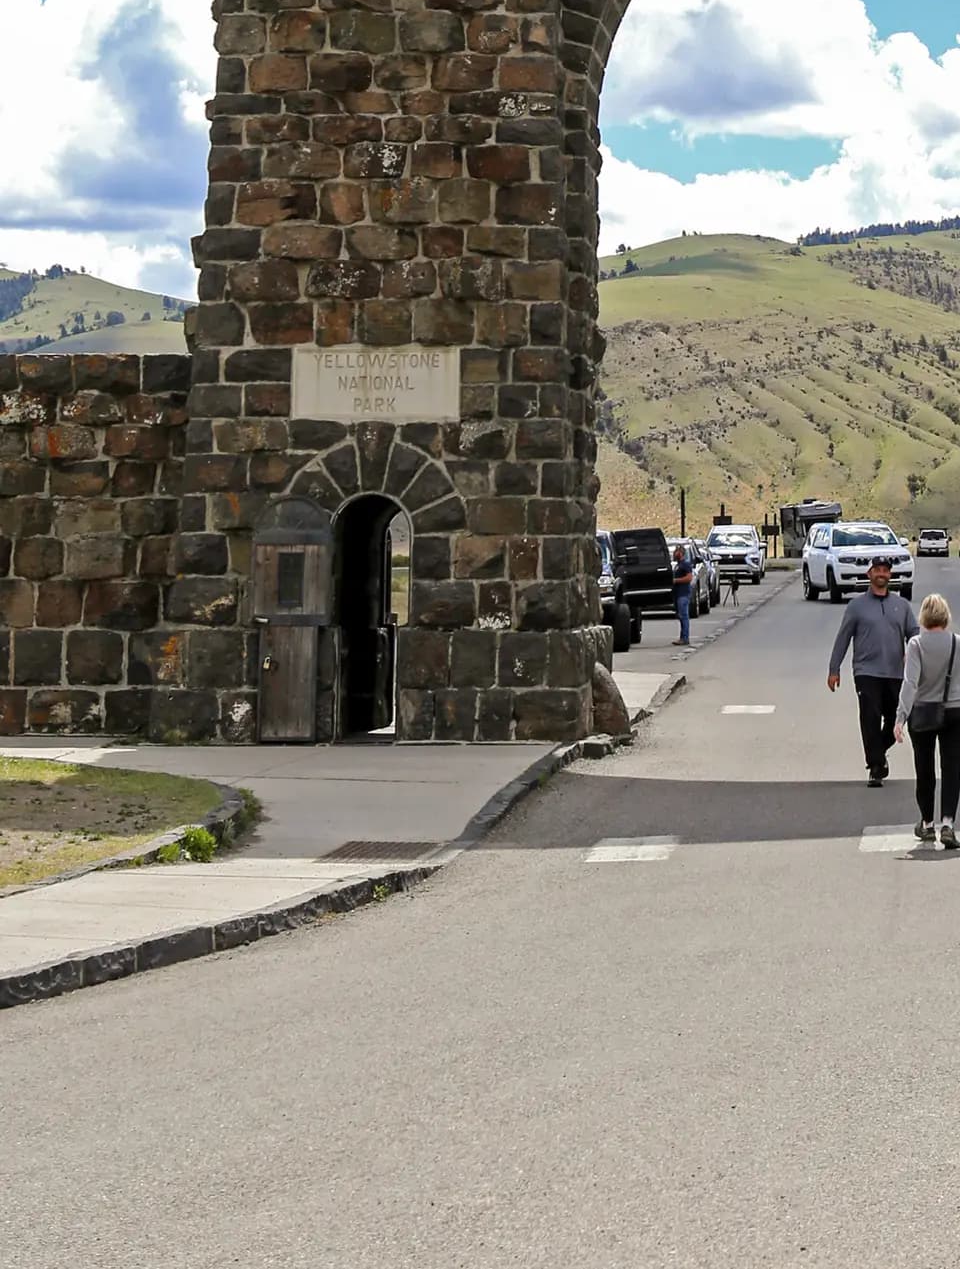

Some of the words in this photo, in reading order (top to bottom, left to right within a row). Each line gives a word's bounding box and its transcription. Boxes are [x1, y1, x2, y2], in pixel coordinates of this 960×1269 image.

[313, 353, 440, 369] YELLOWSTONE
[338, 376, 415, 391] NATIONAL
[353, 397, 397, 413] PARK
